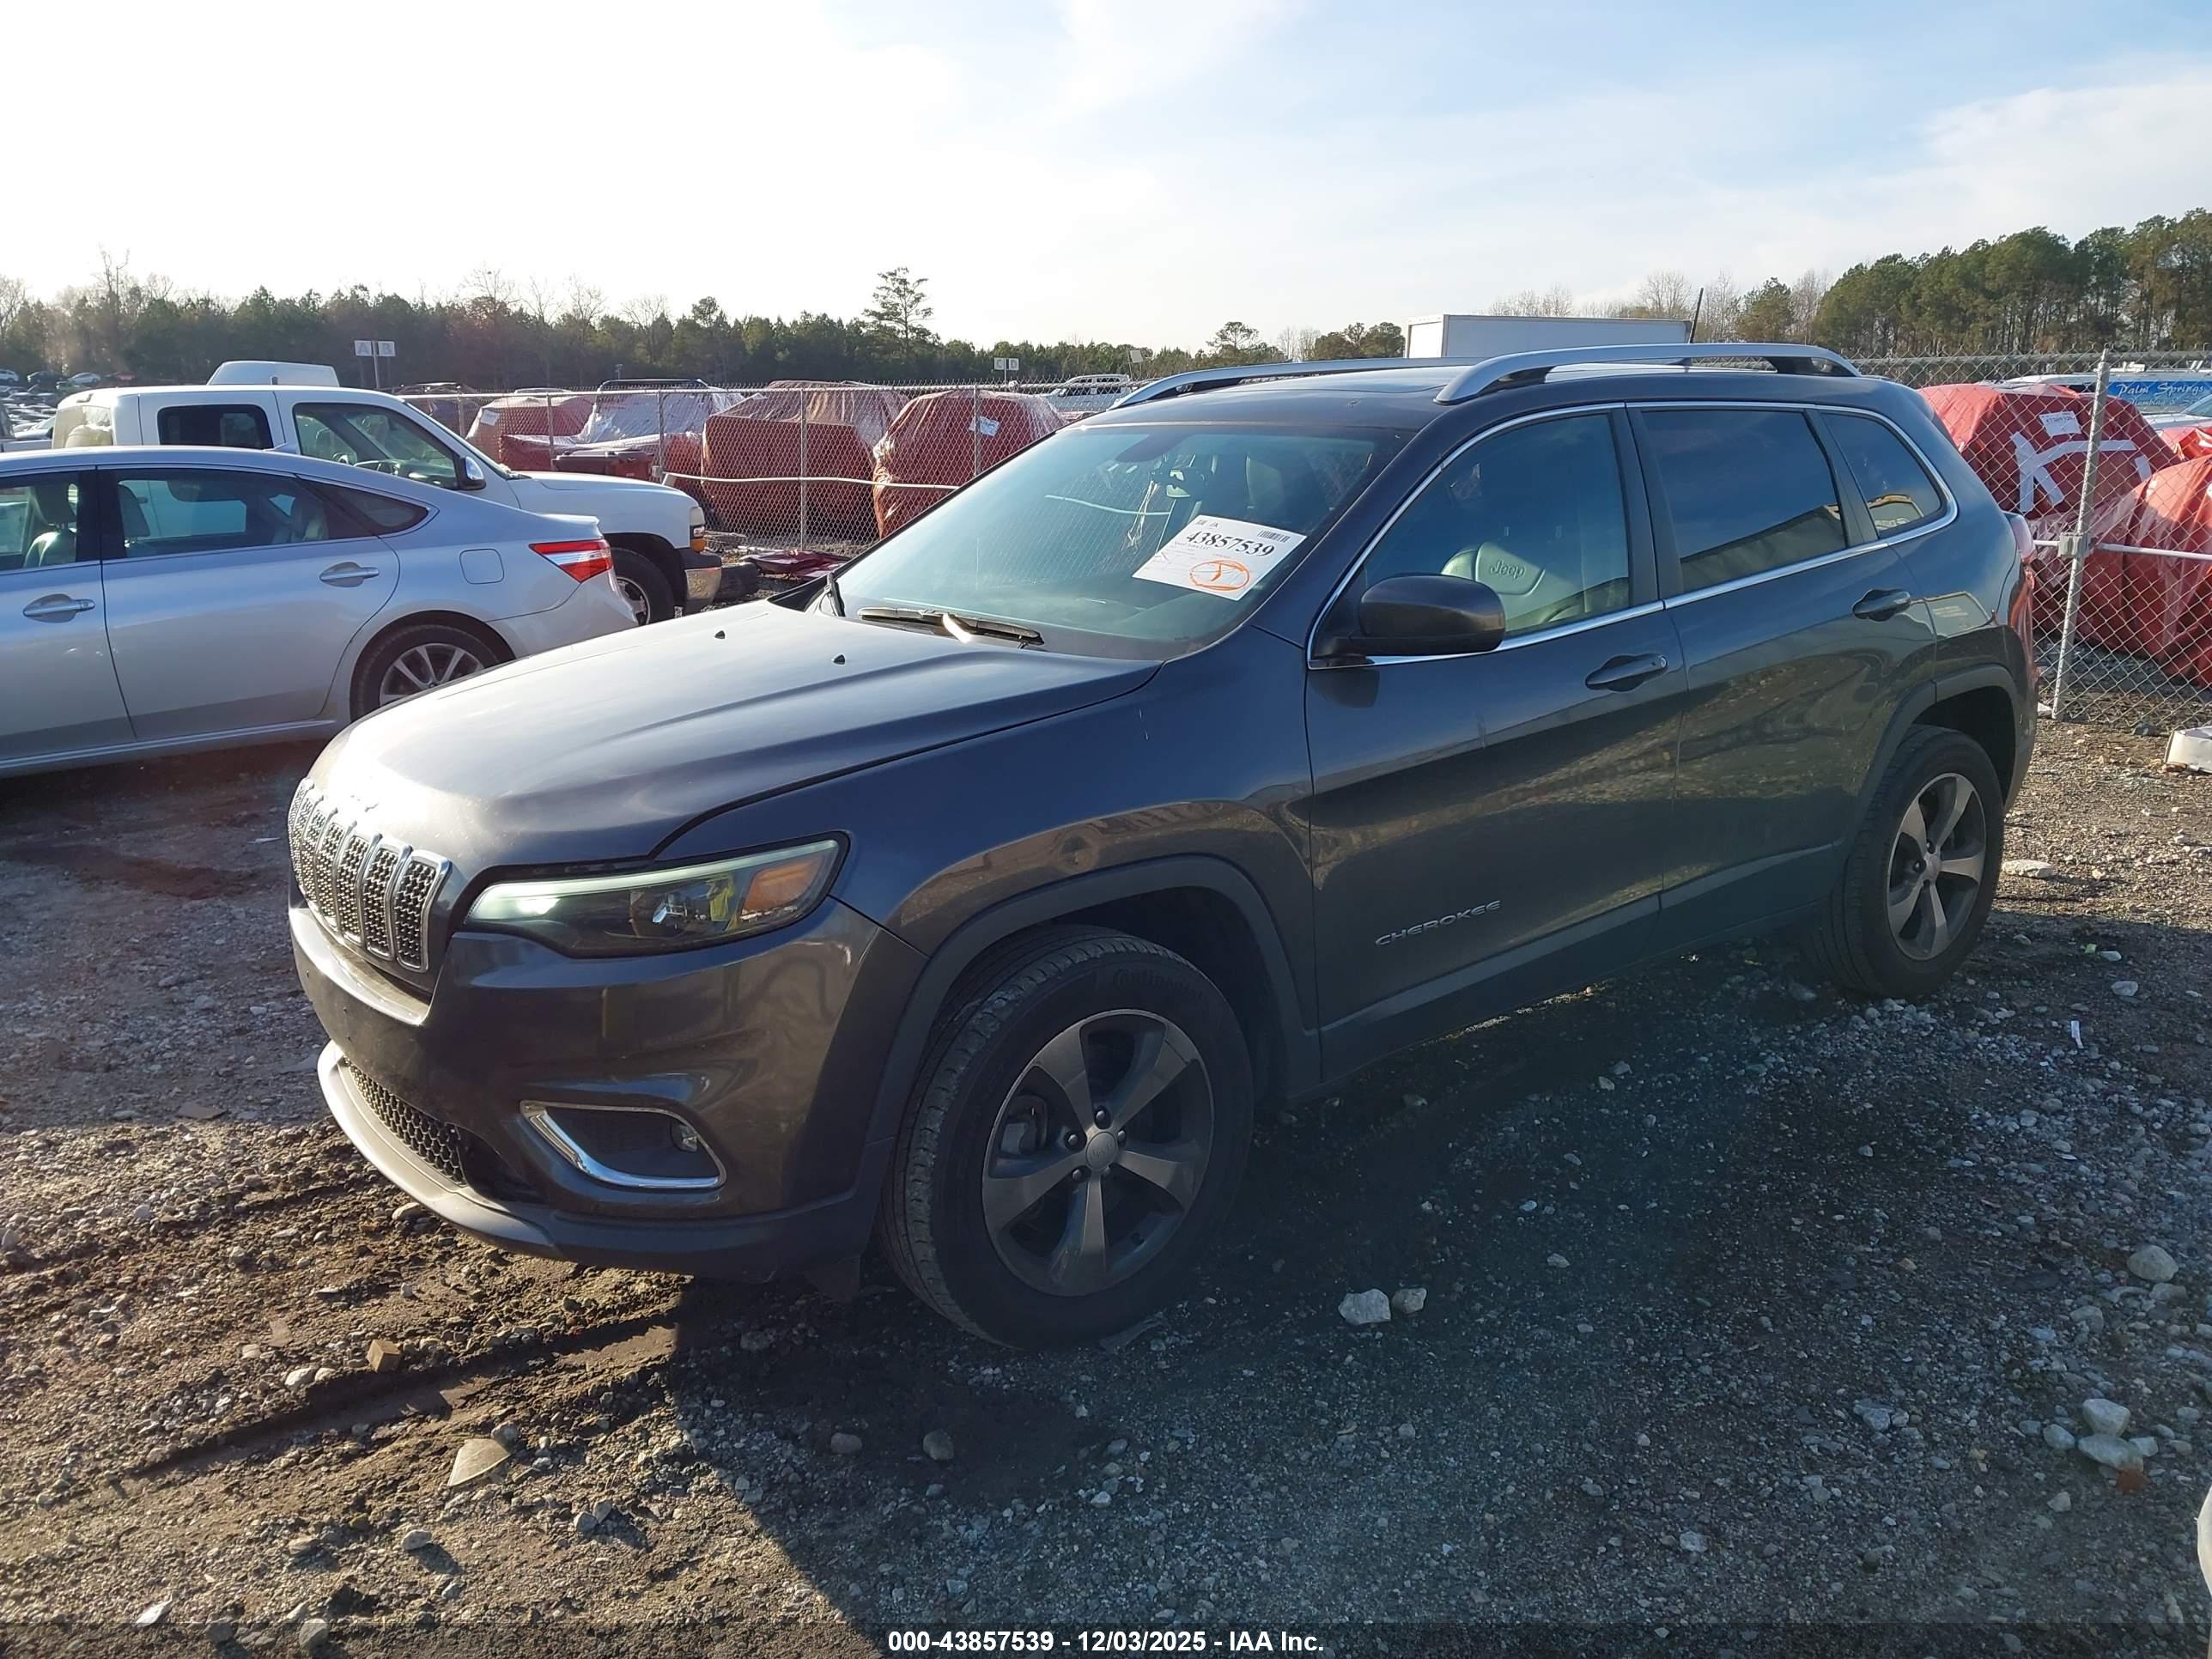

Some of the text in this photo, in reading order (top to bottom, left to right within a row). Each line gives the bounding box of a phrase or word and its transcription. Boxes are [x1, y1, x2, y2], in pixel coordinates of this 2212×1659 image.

[2115, 383, 2205, 397] Palm Springs
[1186, 530, 1276, 557] 43857539
[1490, 560, 1526, 580] Jeep
[1375, 900, 1501, 945] CHEROKEE
